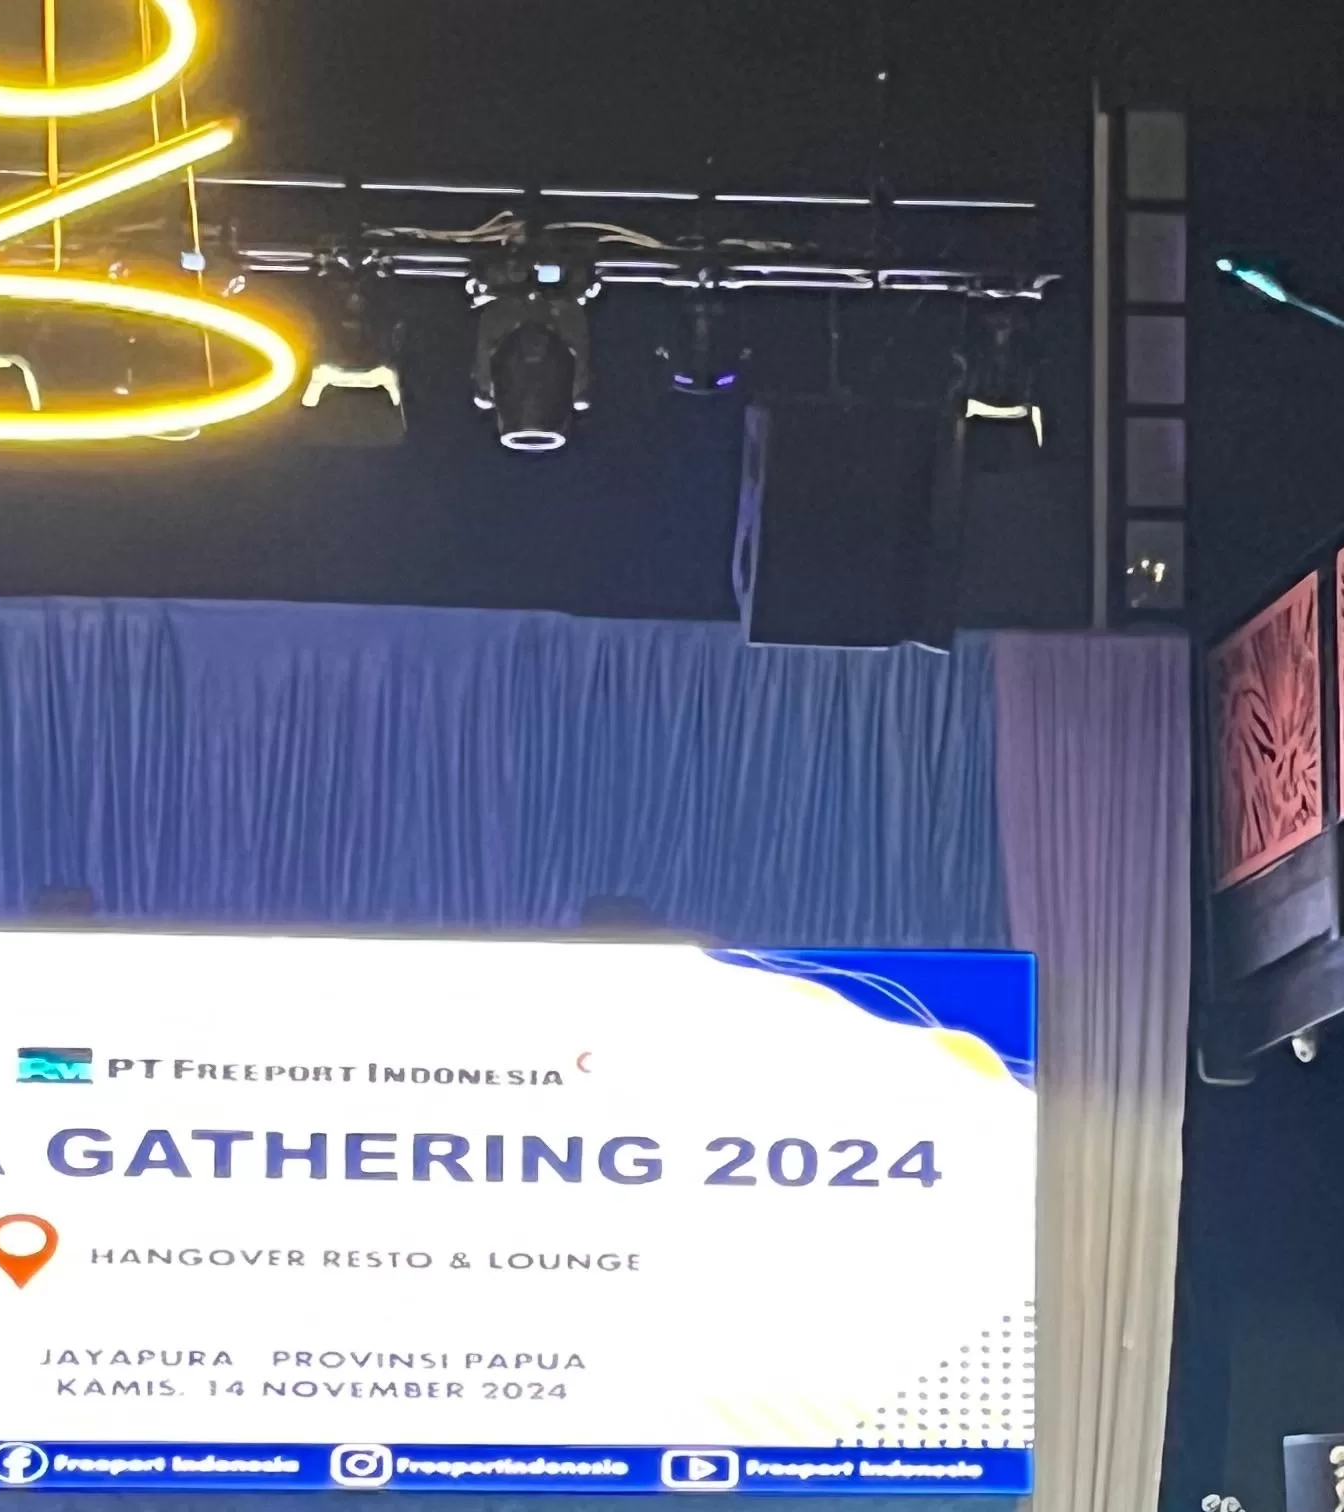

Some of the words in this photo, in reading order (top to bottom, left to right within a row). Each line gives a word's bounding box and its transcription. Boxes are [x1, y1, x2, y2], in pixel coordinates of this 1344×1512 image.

[108, 1058, 163, 1080] PT
[46, 1127, 663, 1185] GATHERING
[703, 1136, 943, 1188] 2024
[90, 1248, 305, 1267] HANGOVER
[323, 1250, 433, 1269] RESTO
[449, 1251, 471, 1270] &
[489, 1252, 641, 1272] LOUNGE
[40, 1348, 233, 1367] JAYAPURA
[272, 1350, 448, 1369] PROVINSI
[464, 1352, 587, 1370] PAPUA
[208, 1380, 246, 1397] 14
[263, 1380, 465, 1398] NOVEMBER
[482, 1382, 568, 1400] 2024
